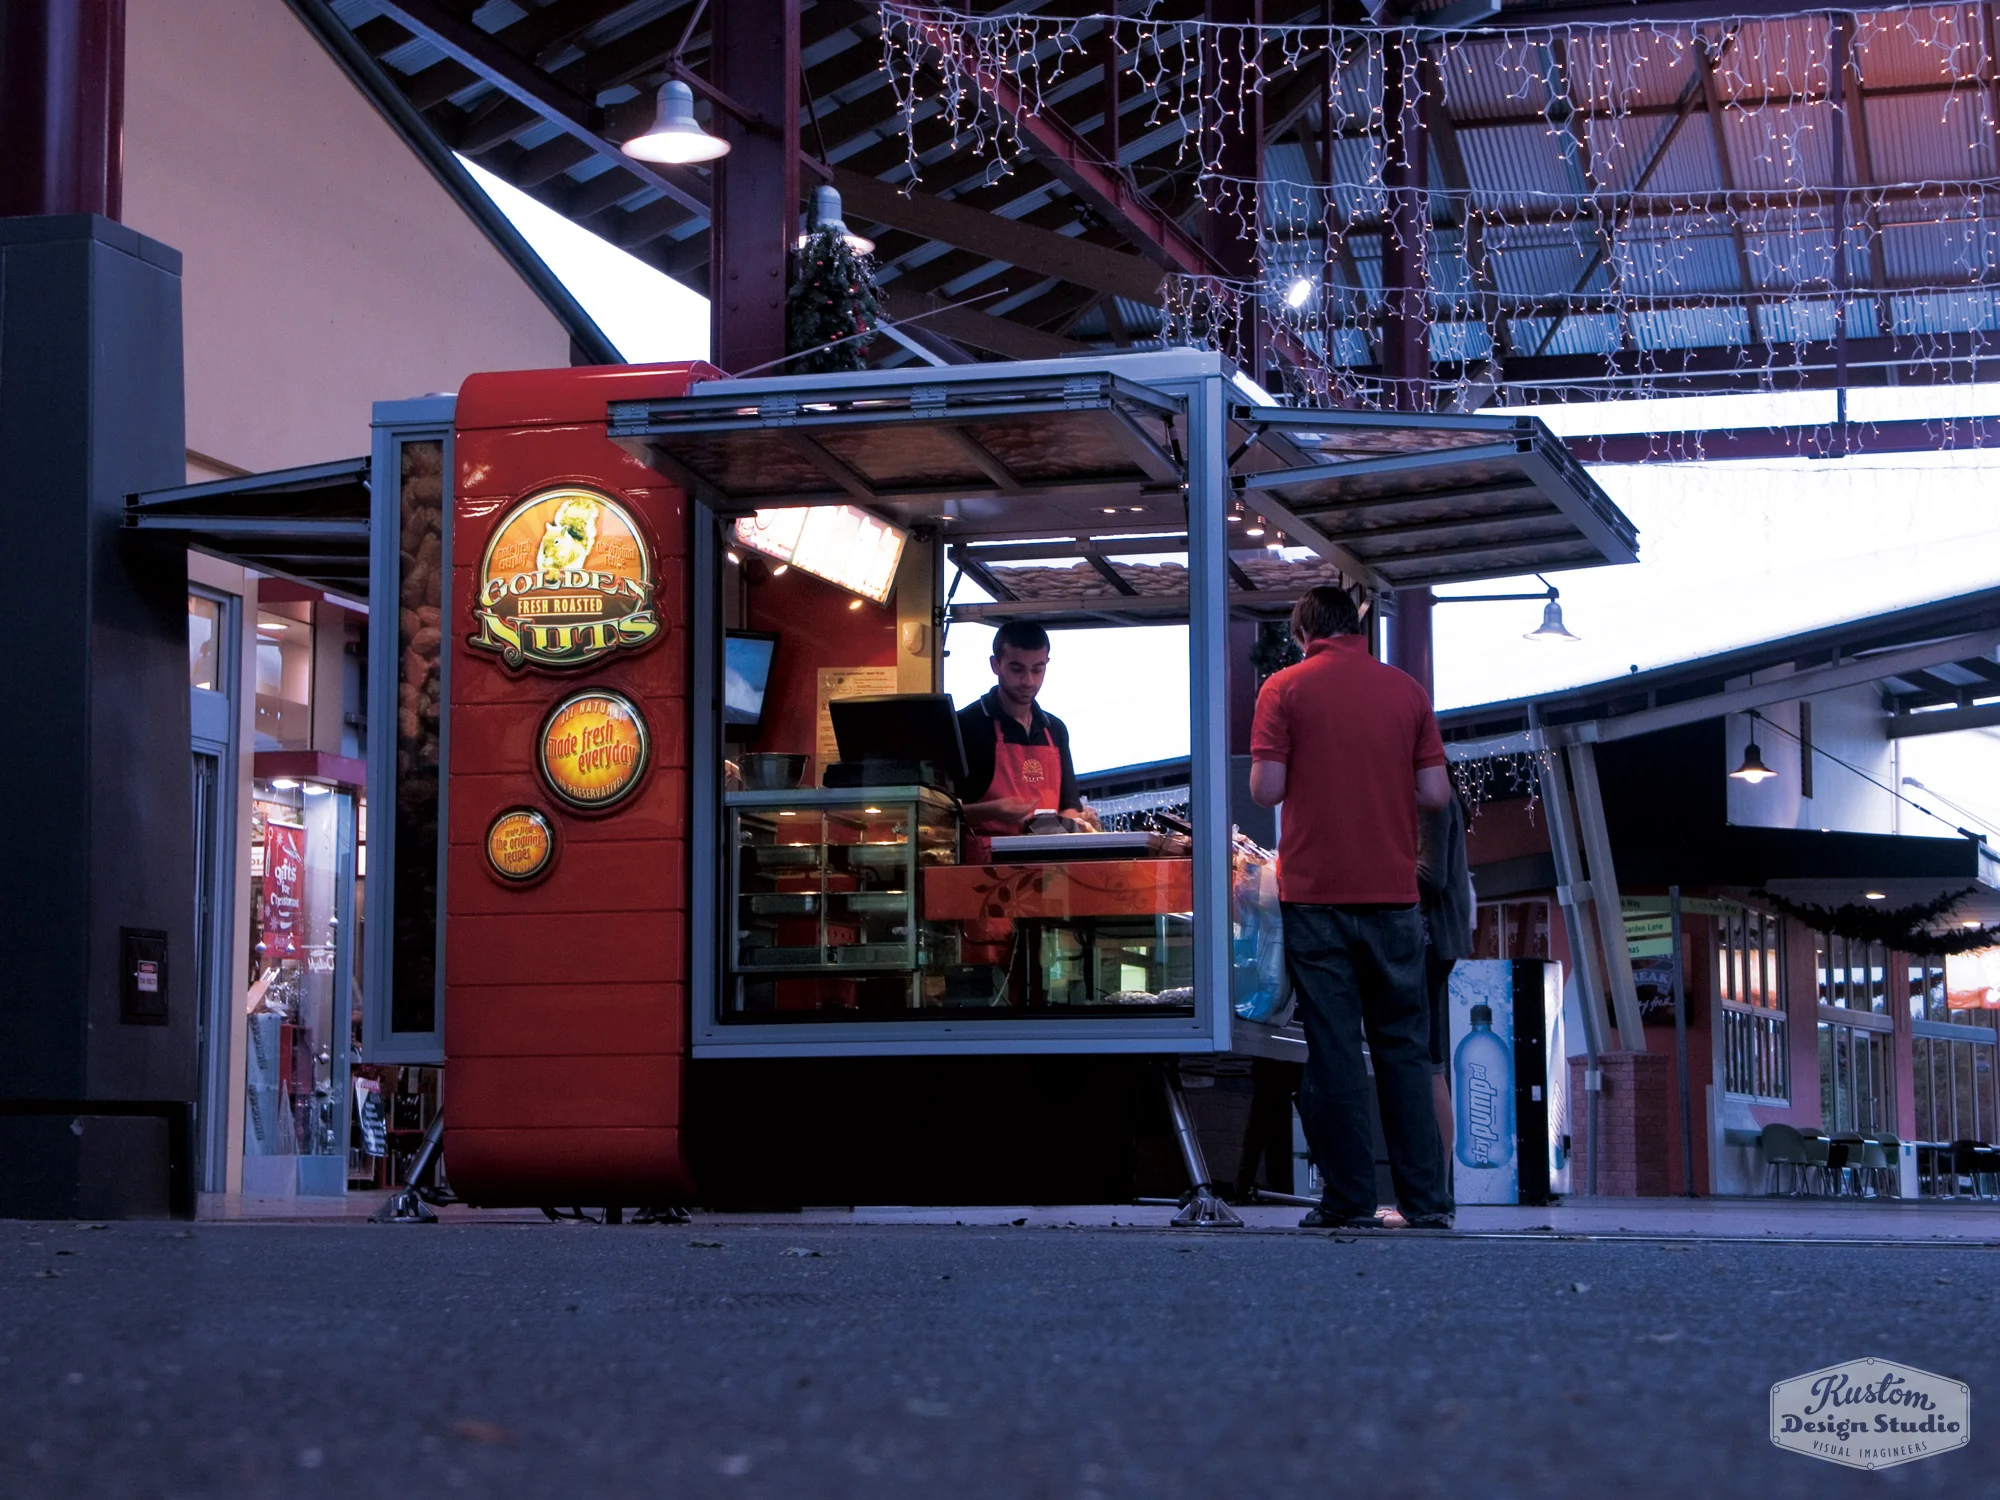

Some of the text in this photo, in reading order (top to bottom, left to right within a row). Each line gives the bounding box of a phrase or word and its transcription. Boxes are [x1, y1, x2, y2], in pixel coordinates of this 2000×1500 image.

[482, 569, 654, 607] GOLDEN
[518, 598, 603, 614] FRESH ROASTED
[468, 610, 660, 667] NUTS
[579, 701, 624, 724] NATURAL
[547, 720, 614, 759] made fresh
[578, 740, 637, 773] everyday
[568, 774, 625, 799] PRESERVATIVES
[509, 835, 541, 851] original
[274, 858, 297, 885] gifts
[281, 881, 291, 895] for
[1647, 921, 1664, 933] Lane
